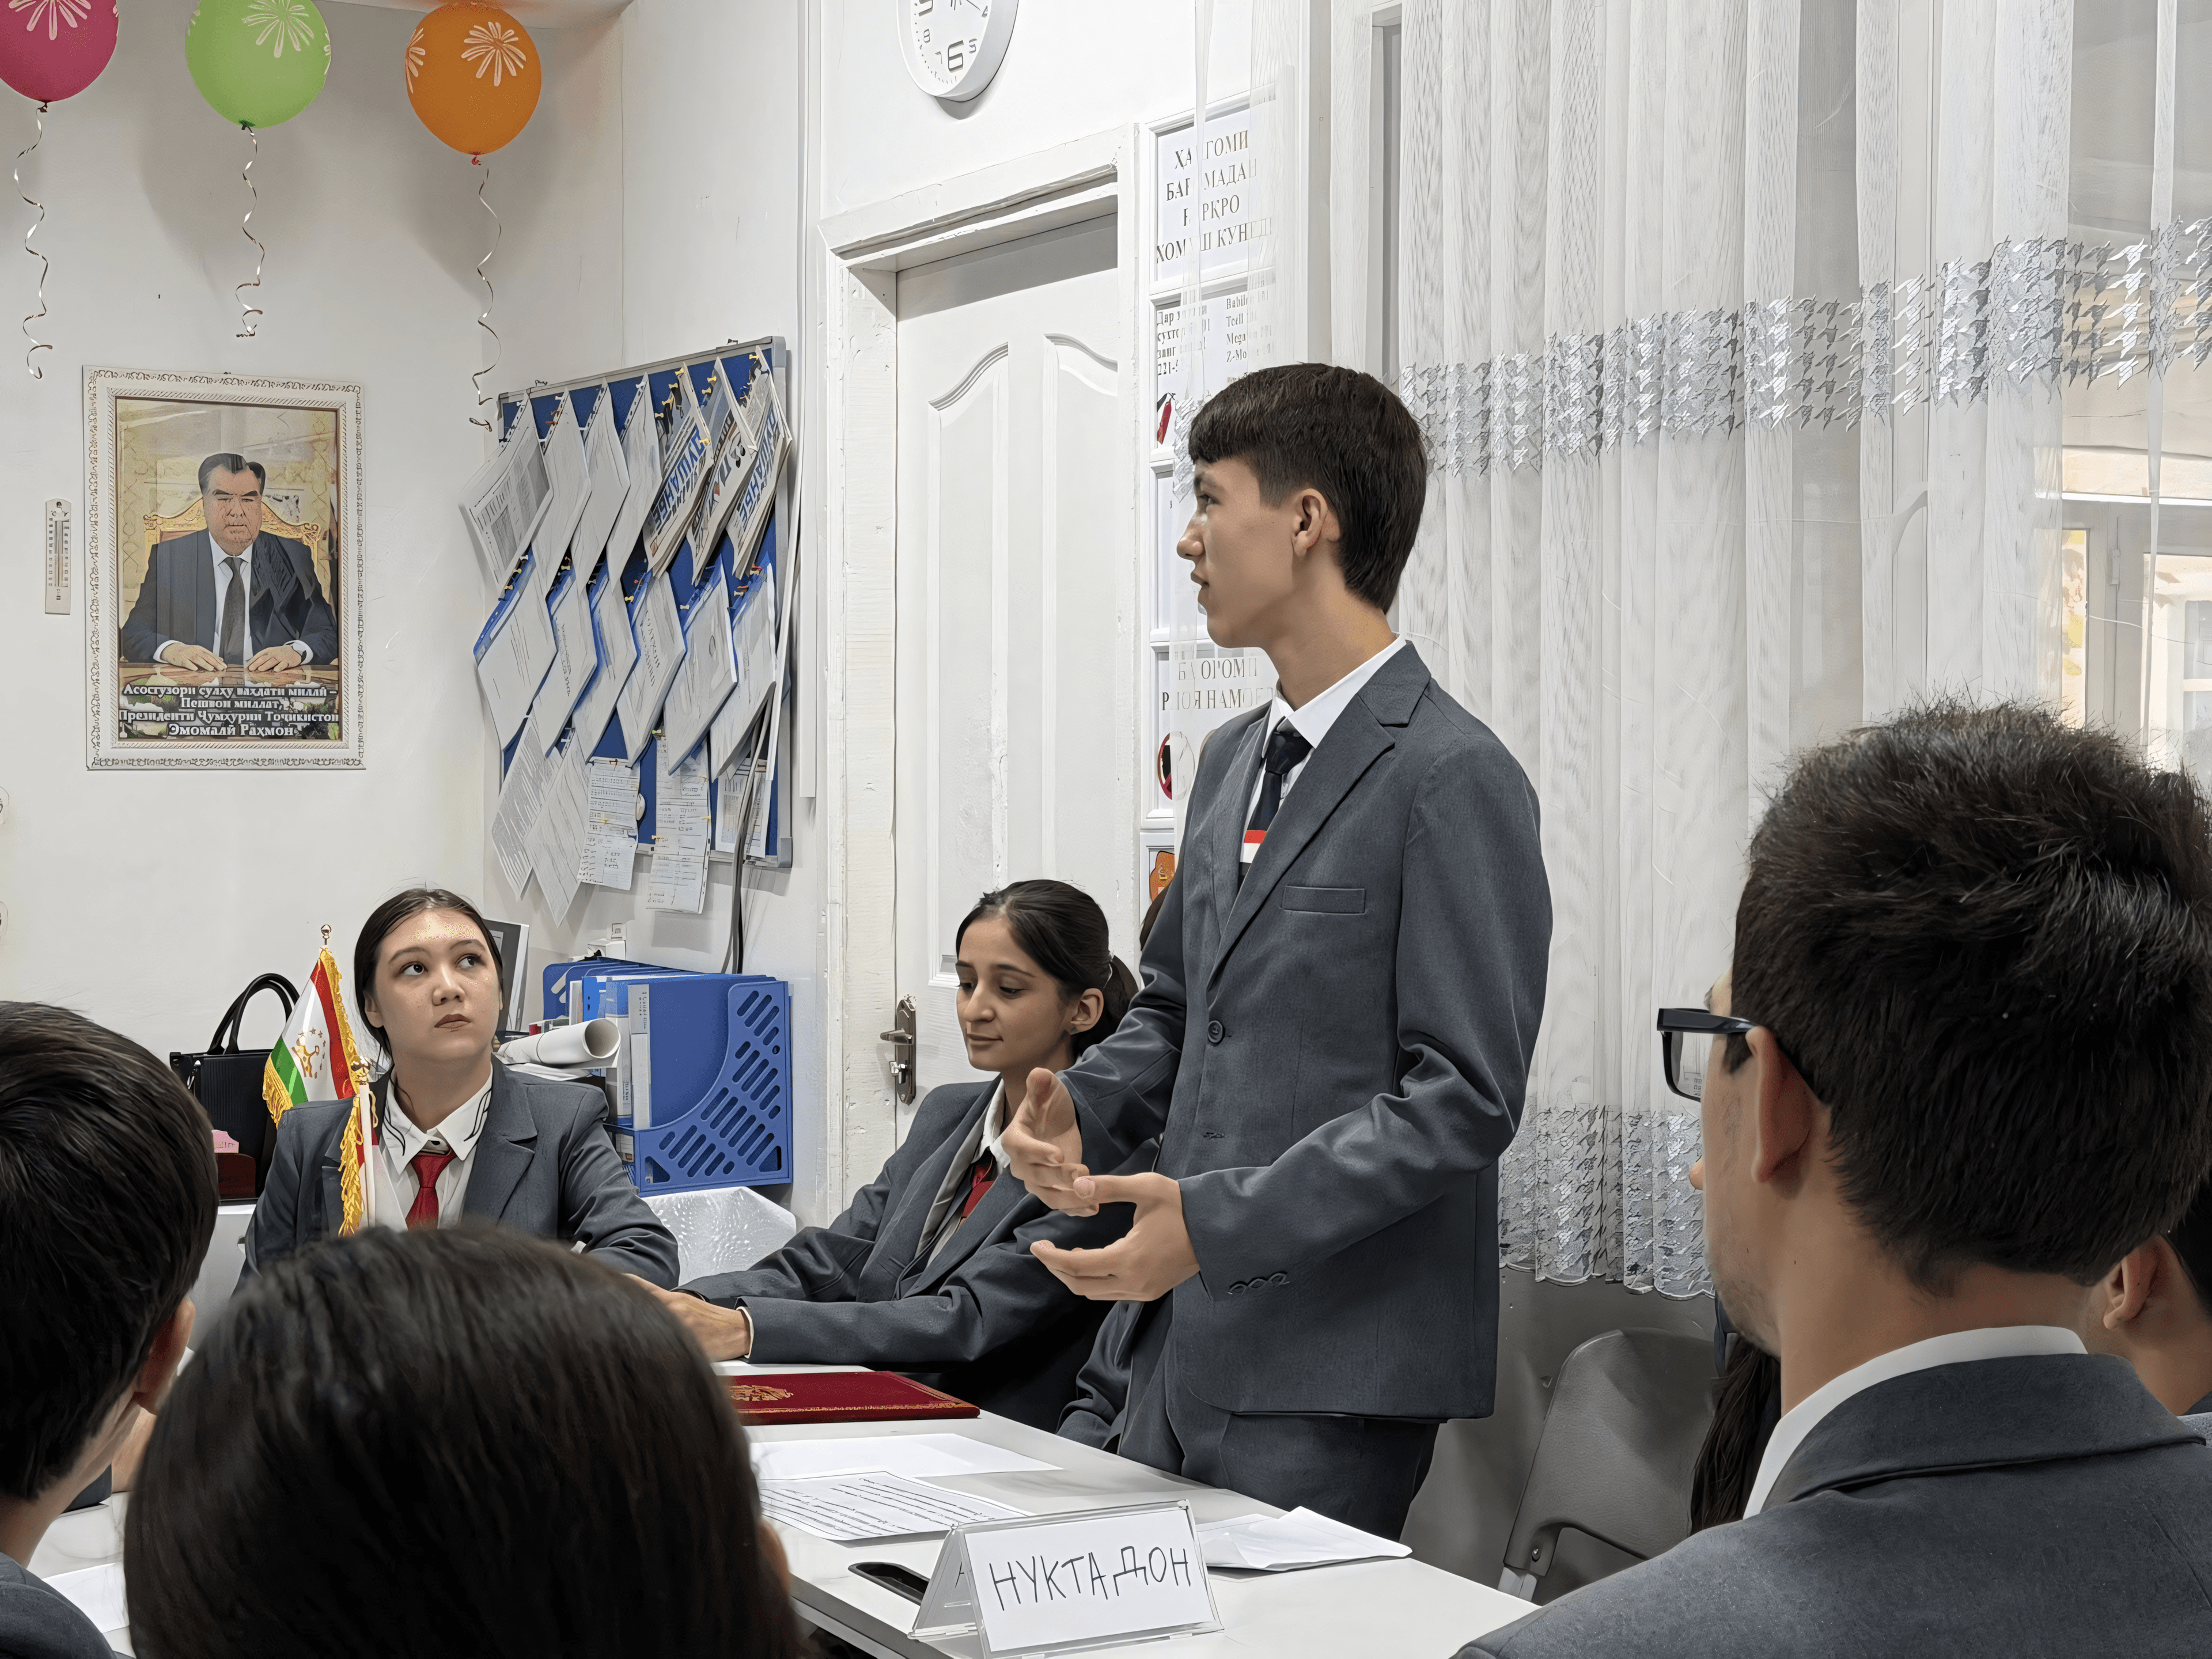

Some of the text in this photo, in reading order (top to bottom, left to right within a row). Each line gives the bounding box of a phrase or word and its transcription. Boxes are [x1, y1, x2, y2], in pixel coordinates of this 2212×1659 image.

[923, 28, 931, 44] 8
[935, 38, 978, 73] 7 6 5
[988, 1546, 1191, 1611] НУКТАДОН
